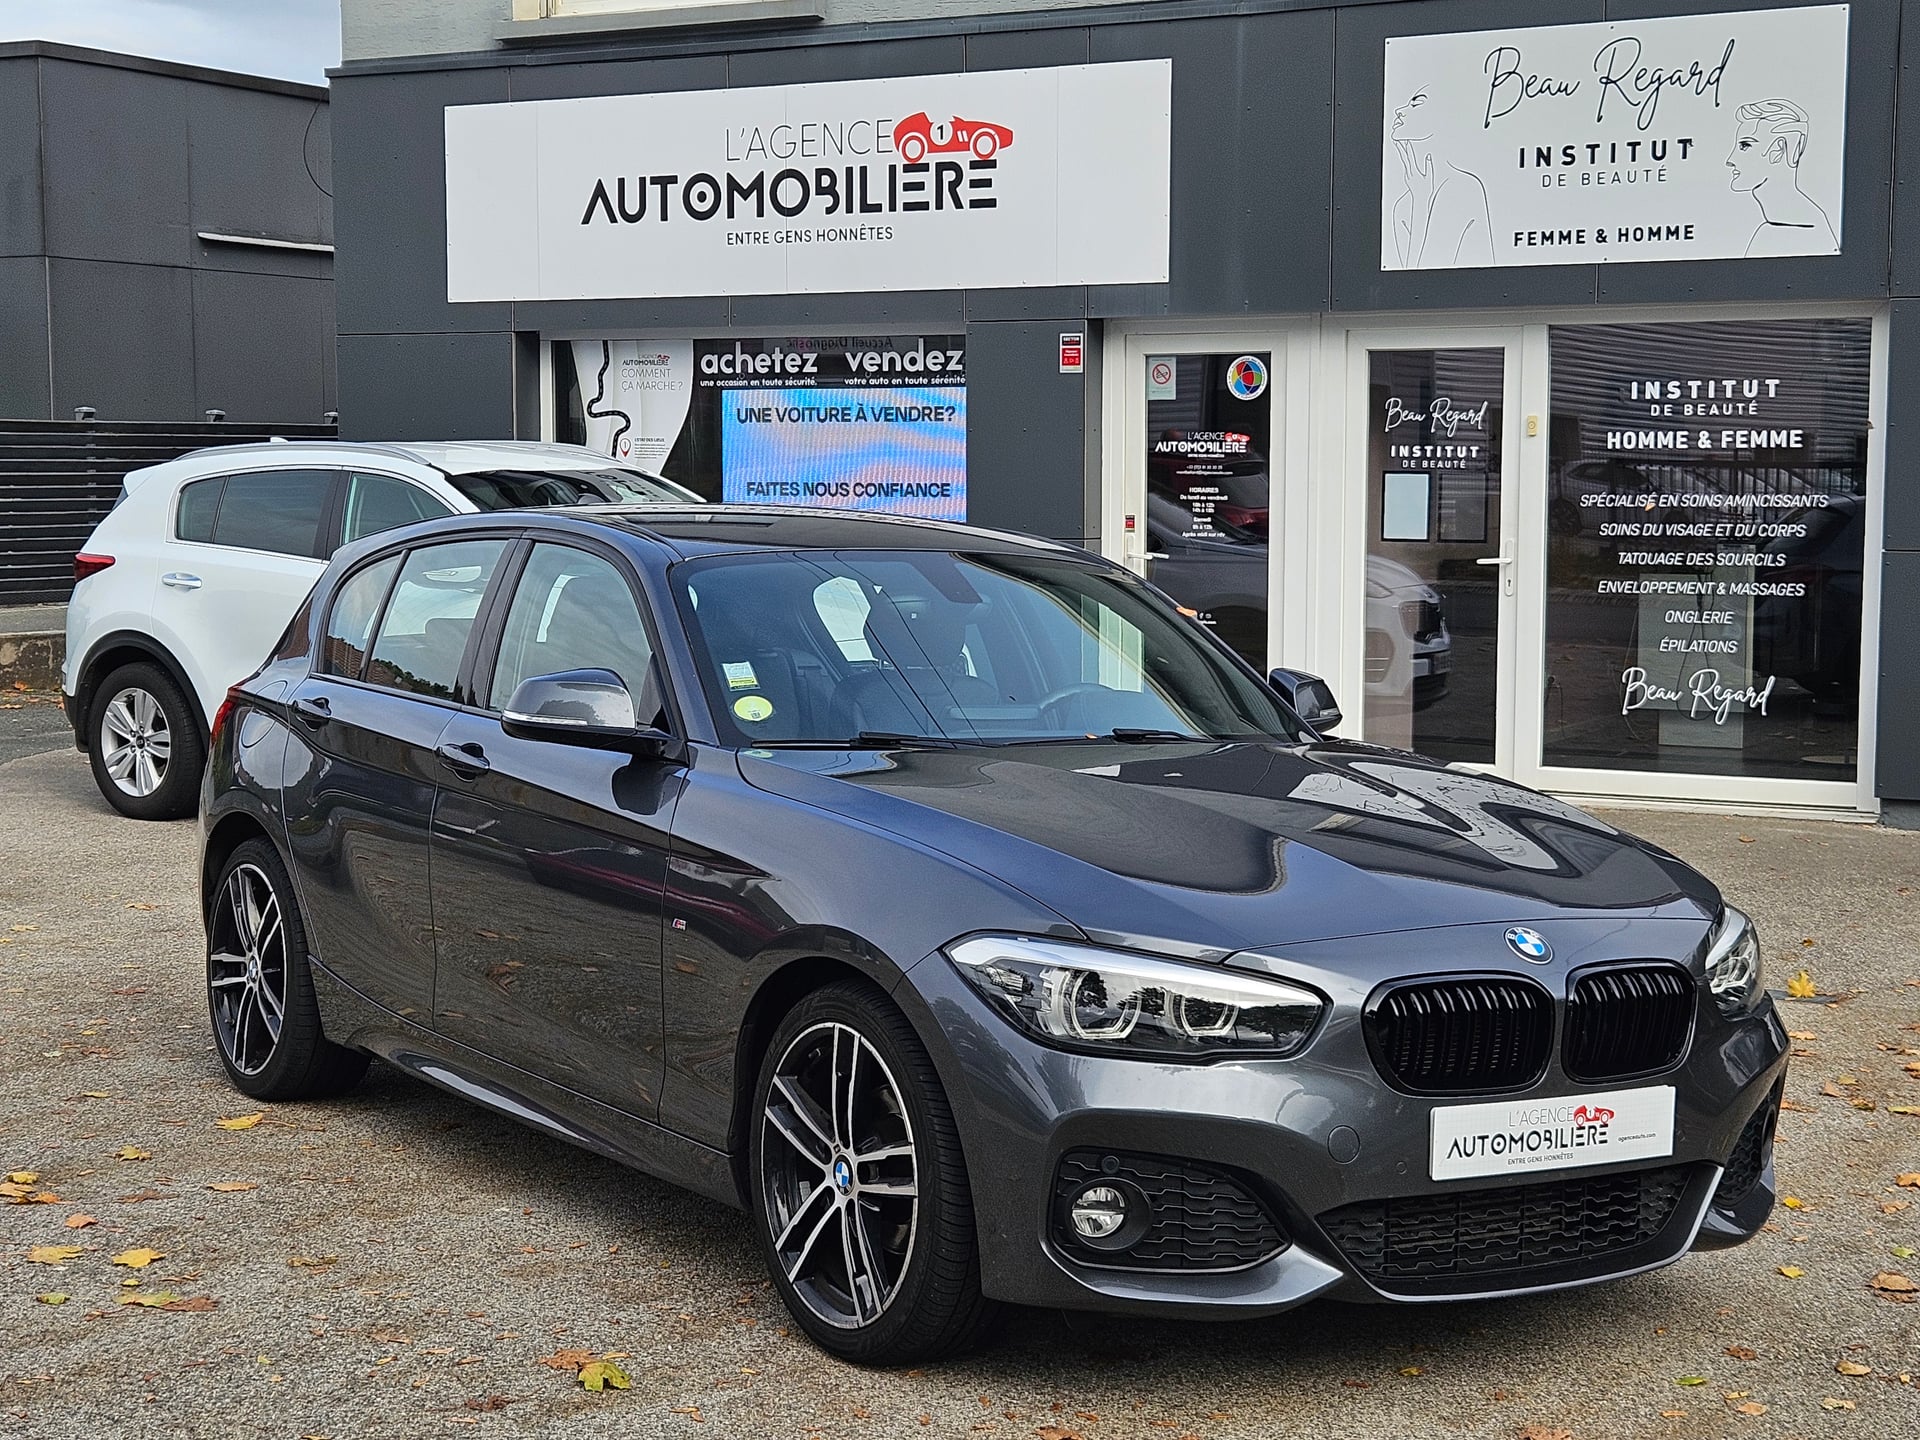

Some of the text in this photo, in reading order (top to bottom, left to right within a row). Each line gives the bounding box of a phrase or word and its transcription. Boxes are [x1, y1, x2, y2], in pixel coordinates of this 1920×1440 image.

[1485, 36, 1735, 131] Beau Regard
[936, 124, 945, 140] 1
[725, 119, 893, 162] L'AGENCE
[1519, 138, 1693, 168] INSTITUT
[1542, 164, 1667, 188] DE BEAUTÉ
[727, 223, 893, 246] ENTRE GENS HONNÊTES
[1514, 224, 1695, 247] FEMME & HOMME
[700, 337, 963, 374] achetez vendez
[621, 368, 671, 378] COMMENT
[844, 375, 966, 385] votre auto en toute sérénité
[621, 381, 684, 392] ÇA MARCHE ?
[700, 379, 714, 387] une
[716, 378, 748, 387] occasion
[762, 378, 783, 386] toute
[785, 377, 817, 386] sécurité.
[1631, 379, 1780, 400] INSTITUT
[737, 403, 956, 423] UNE VOITURE À VENDRE?
[1650, 400, 1758, 416] DE BEAUTÉ
[1385, 397, 1488, 438] Beau Regard
[1187, 432, 1225, 440] L'AGENCE
[1607, 429, 1803, 450] HOMME & FEMME
[1390, 445, 1480, 458] INSTITUT
[1402, 459, 1466, 469] DE BEAUTÉ
[746, 482, 951, 498] FAITES NOUS CONFIANCE
[1579, 492, 1830, 508] SPÉCIALISÉ EN SOINS AMINCISSANTS
[1599, 523, 1807, 537] SOINS DU VISAGE ET DU CORPS
[1618, 552, 1787, 567] TATOUAGE DES SOURCILS
[1598, 580, 1806, 597] ENVELOPPEMENT & MASSAGES
[1664, 610, 1736, 625] ONGLERIE
[1659, 636, 1739, 654] ÉPILATIONS
[1621, 666, 1776, 726] Beau Regard
[1508, 1106, 1574, 1127] L'AGENCE
[1508, 1152, 1574, 1165] ENTRE GENS HONNÊTES
